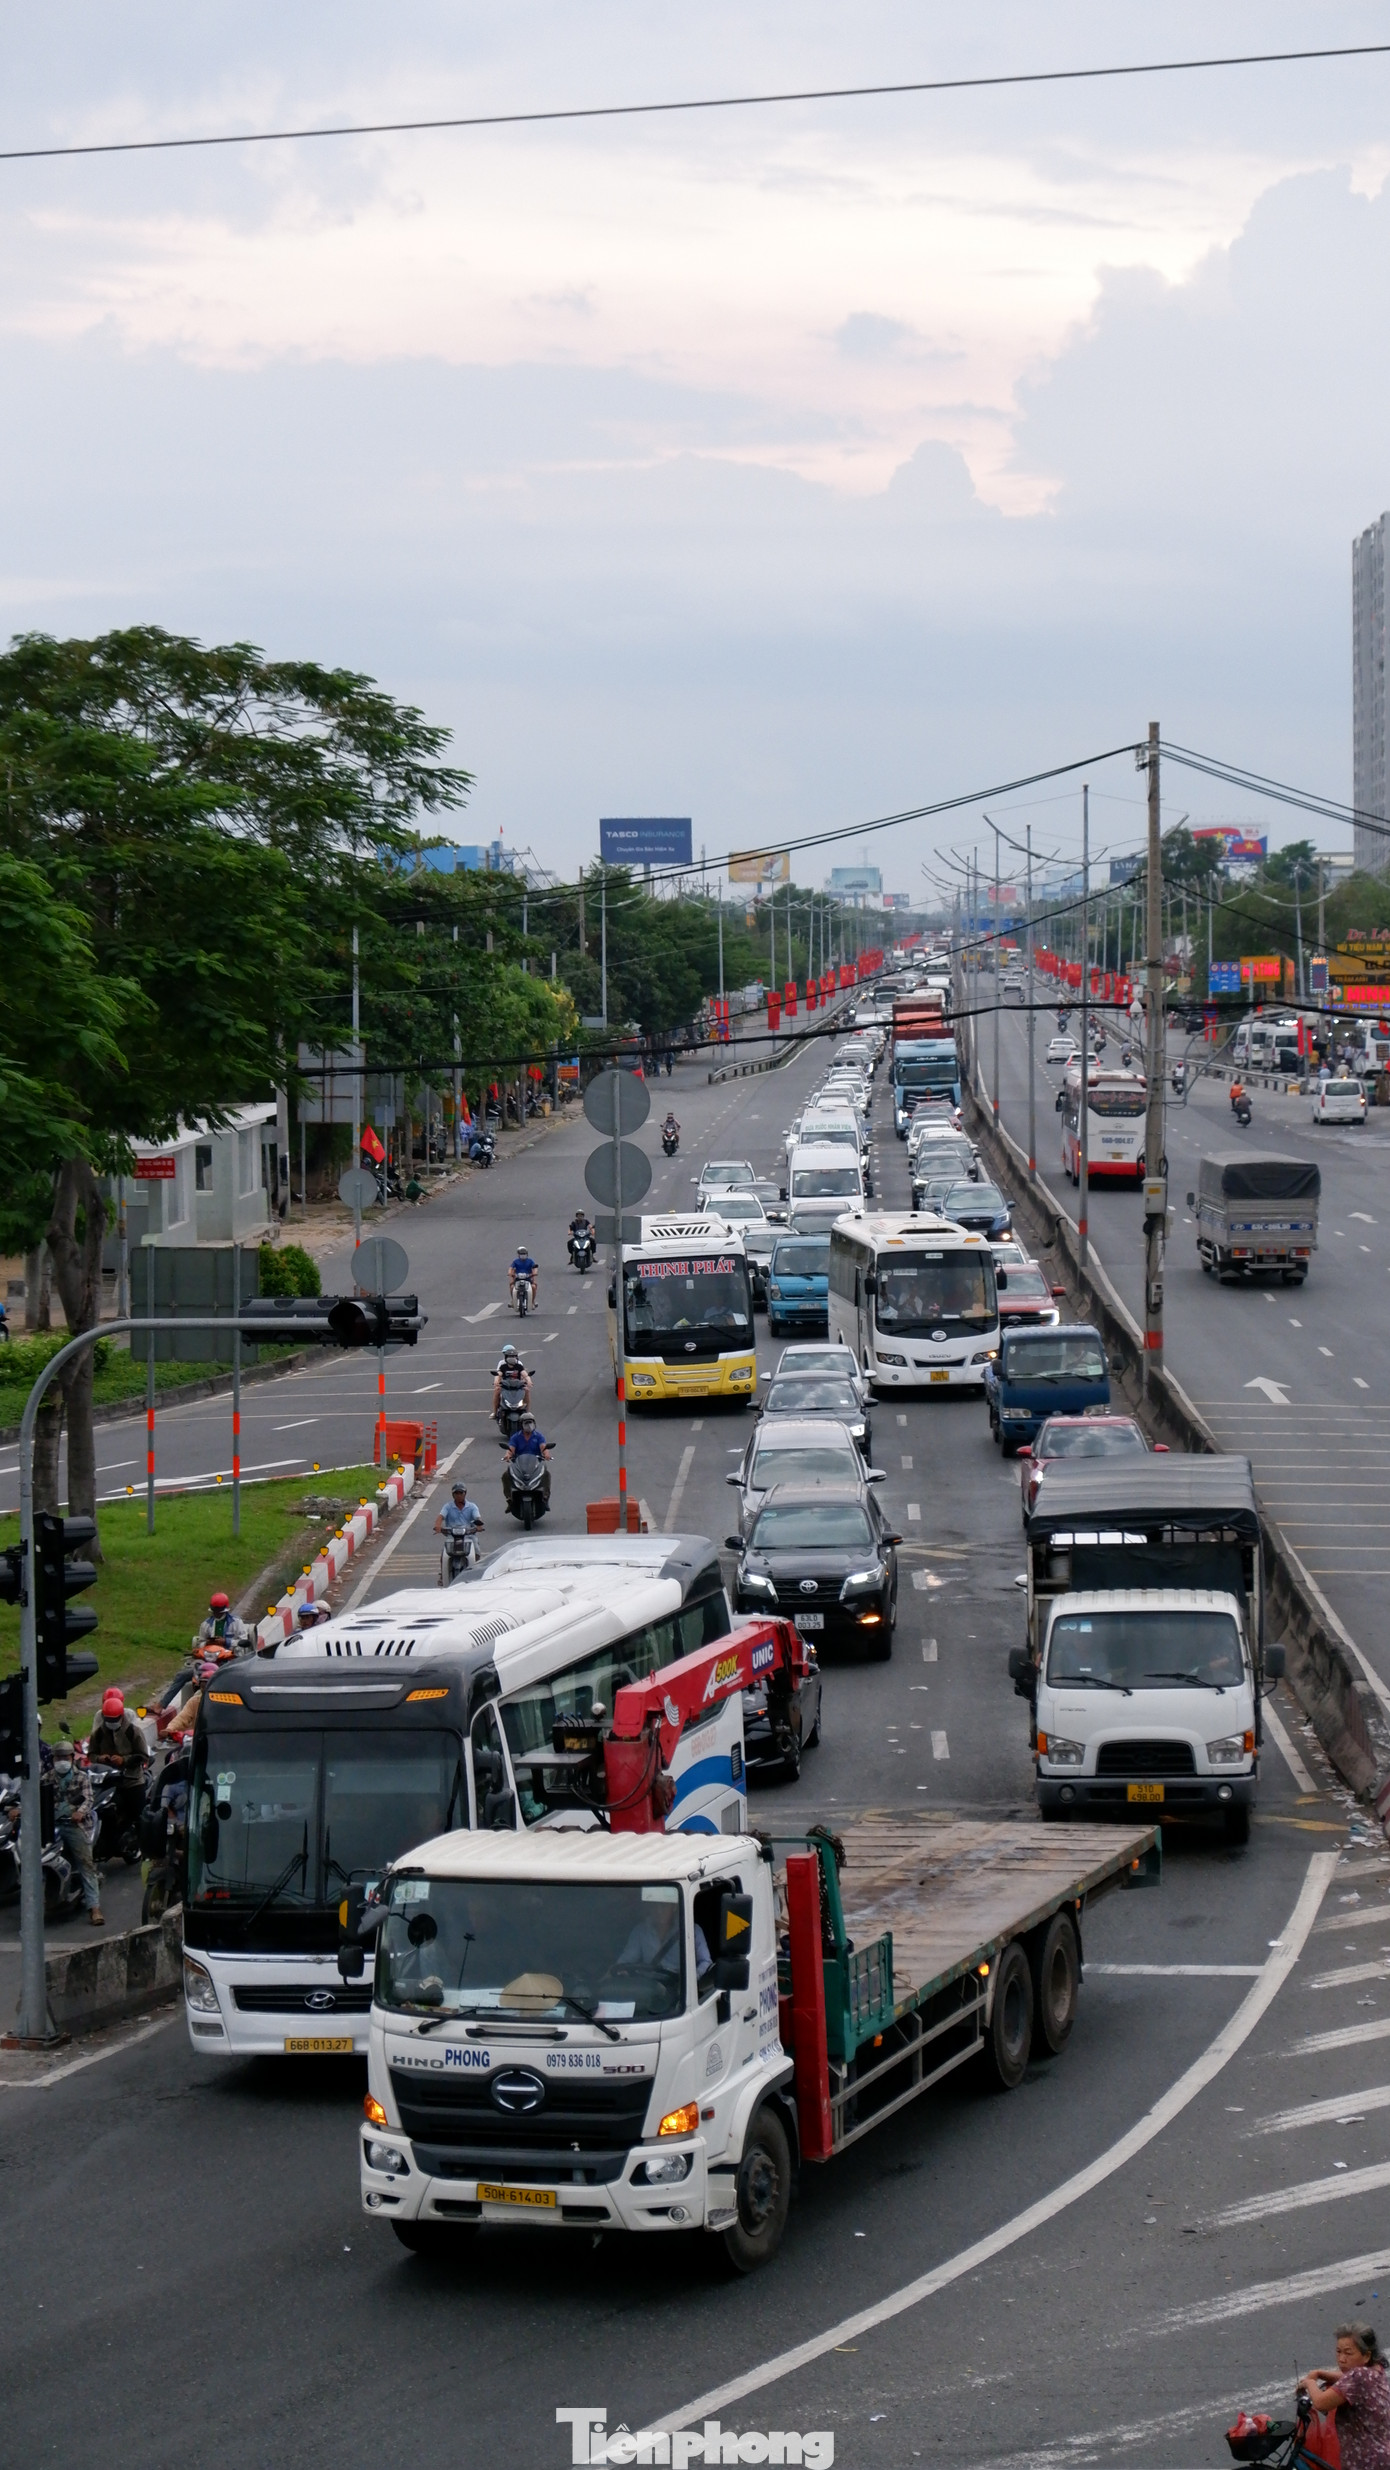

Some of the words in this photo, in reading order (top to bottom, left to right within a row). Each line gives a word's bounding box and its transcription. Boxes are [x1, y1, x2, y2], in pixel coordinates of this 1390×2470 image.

[1347, 986, 1390, 1002] MINH
[637, 1260, 690, 1279] THỊNH
[692, 1256, 735, 1275] PHÁT
[752, 1644, 774, 1669] UNIC
[1131, 1793, 1161, 1801] 498.00
[392, 2055, 444, 2069] HINO
[445, 2048, 490, 2067] PHONG
[546, 2054, 566, 2067] 0979
[568, 2055, 584, 2068] 836
[585, 2055, 601, 2068] 018
[603, 2064, 646, 2075] 500
[484, 2186, 550, 2205] 50H-614.03
